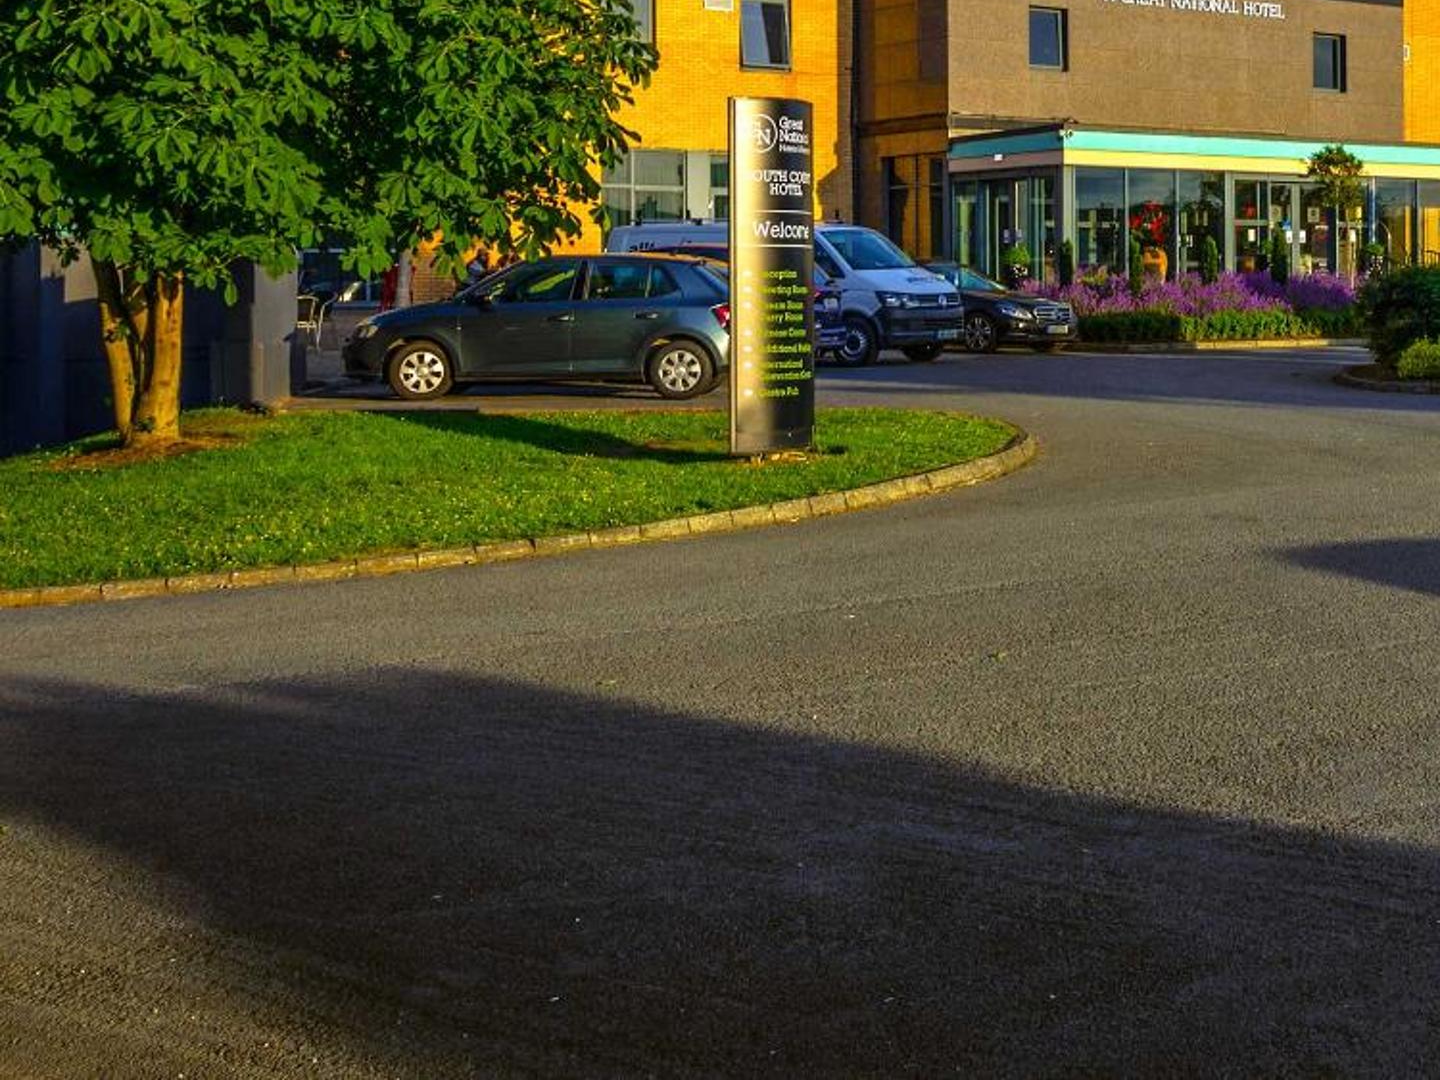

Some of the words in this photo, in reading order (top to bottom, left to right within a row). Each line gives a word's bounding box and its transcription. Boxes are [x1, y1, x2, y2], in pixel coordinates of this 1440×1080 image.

[1243, 0, 1286, 19] HOTEL
[750, 169, 788, 182] OUTH
[769, 182, 803, 196] HOTEL
